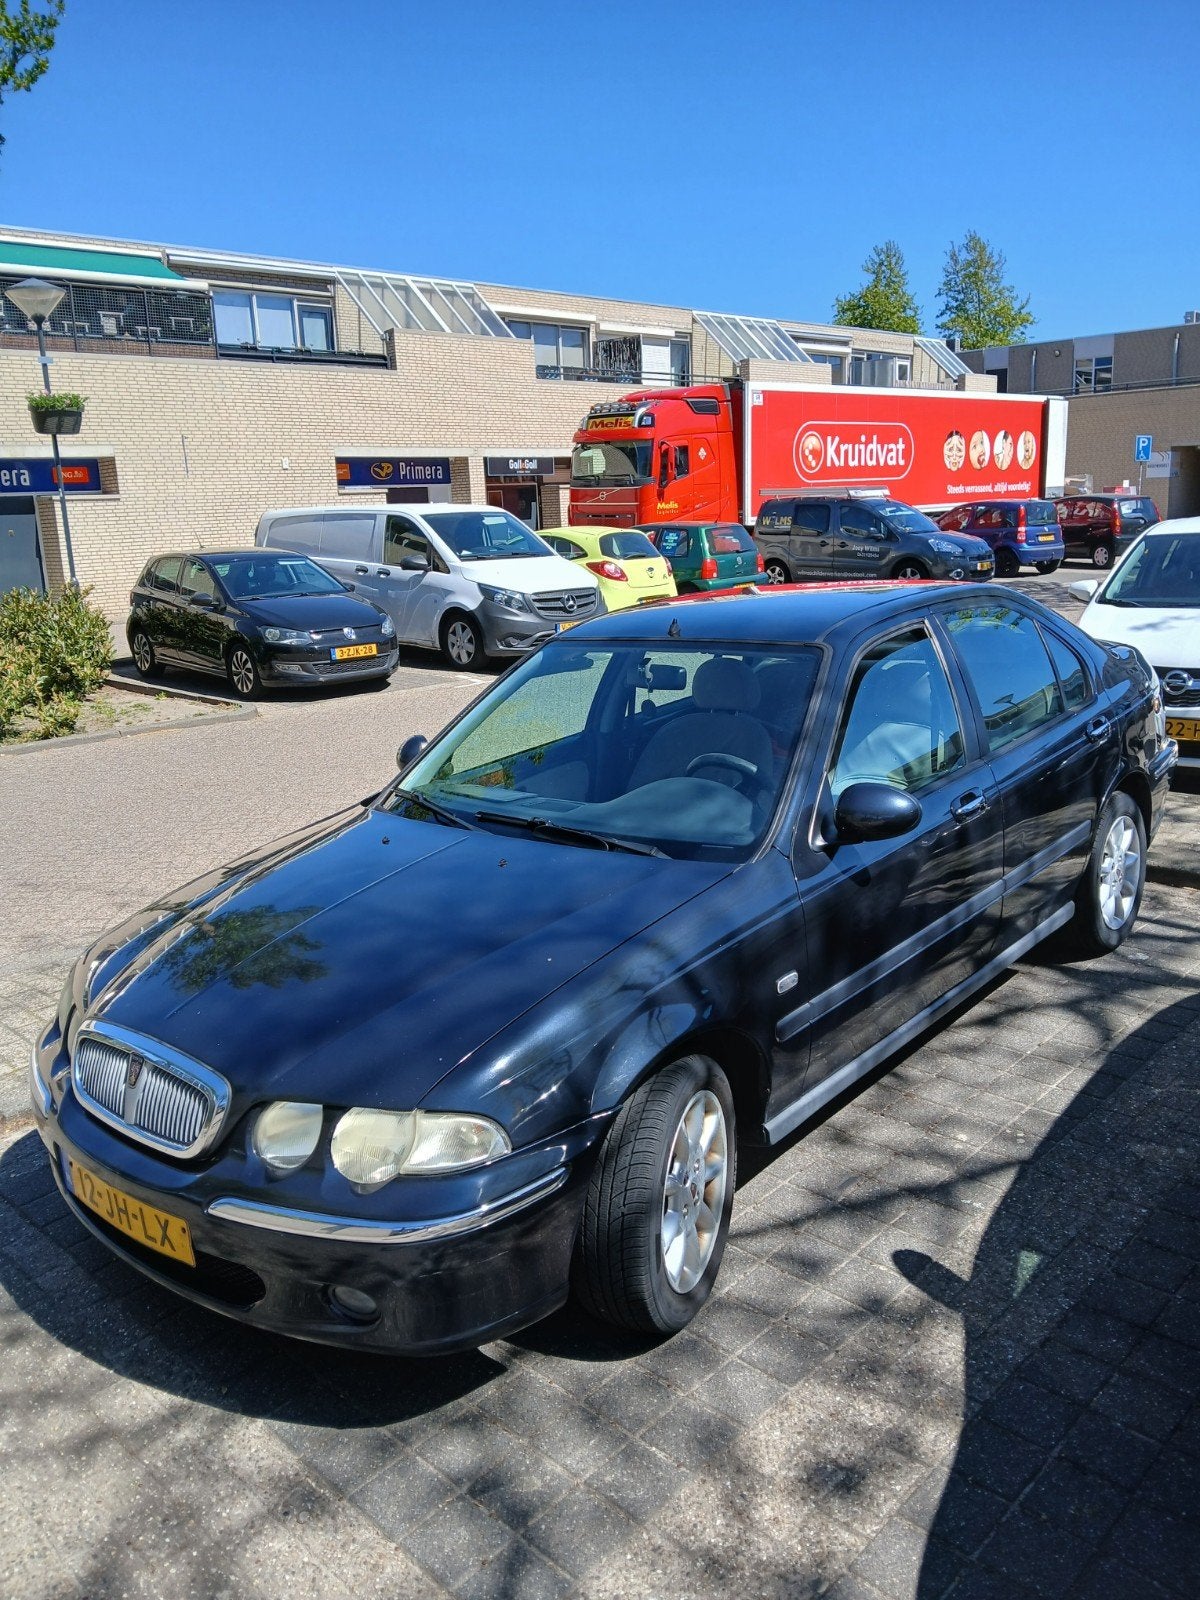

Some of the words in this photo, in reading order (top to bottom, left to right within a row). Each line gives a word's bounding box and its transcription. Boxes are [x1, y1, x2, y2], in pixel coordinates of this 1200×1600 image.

[590, 418, 631, 429] Melis
[826, 434, 906, 467] Kruidvat
[1139, 437, 1149, 451] P
[399, 462, 443, 480] Primera
[657, 501, 679, 509] Melis
[339, 645, 373, 658] 3-ZJK-28
[77, 1166, 177, 1252] 12-JH-LX
